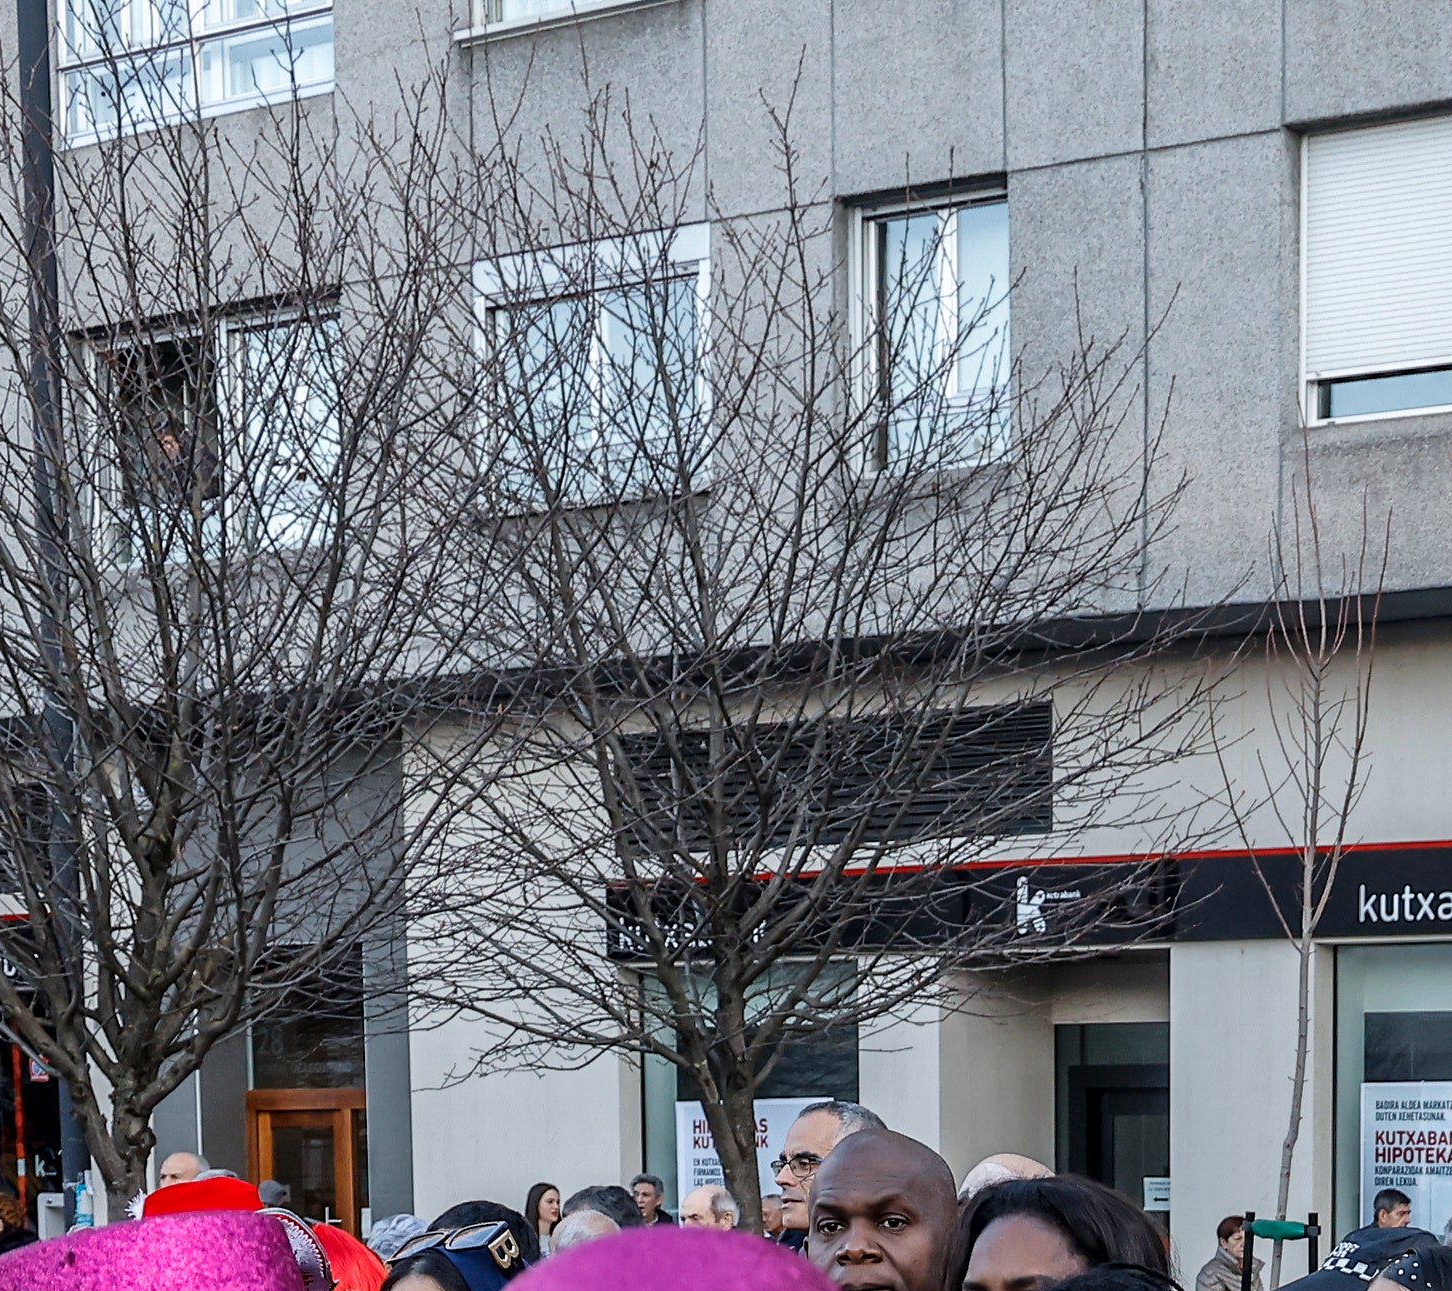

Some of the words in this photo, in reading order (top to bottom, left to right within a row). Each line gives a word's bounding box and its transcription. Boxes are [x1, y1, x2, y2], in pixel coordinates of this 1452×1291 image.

[1375, 1100, 1398, 1109] BADIRA
[1401, 1100, 1421, 1109] ALDEA
[1375, 1112, 1397, 1121] DUTEN
[1375, 1166, 1423, 1175] KONPARAZIOAK
[1375, 1177, 1394, 1186] DIREN
